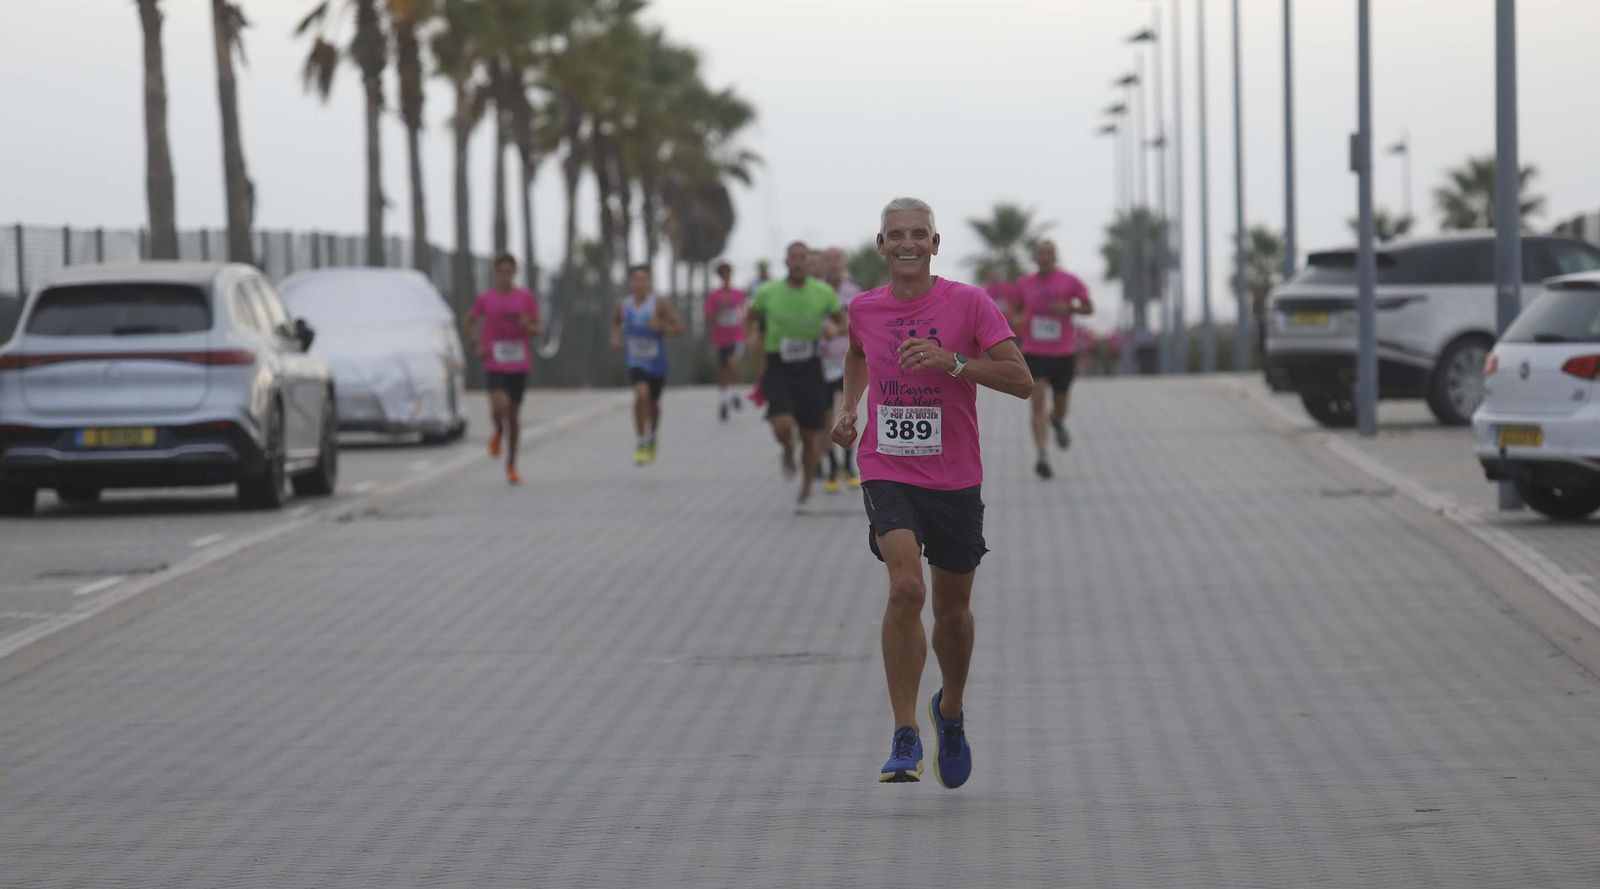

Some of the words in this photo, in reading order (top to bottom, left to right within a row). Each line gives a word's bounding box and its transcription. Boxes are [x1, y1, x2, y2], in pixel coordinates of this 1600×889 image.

[879, 380, 899, 395] VIII
[900, 384, 942, 395] Carrera
[885, 419, 932, 440] 389
